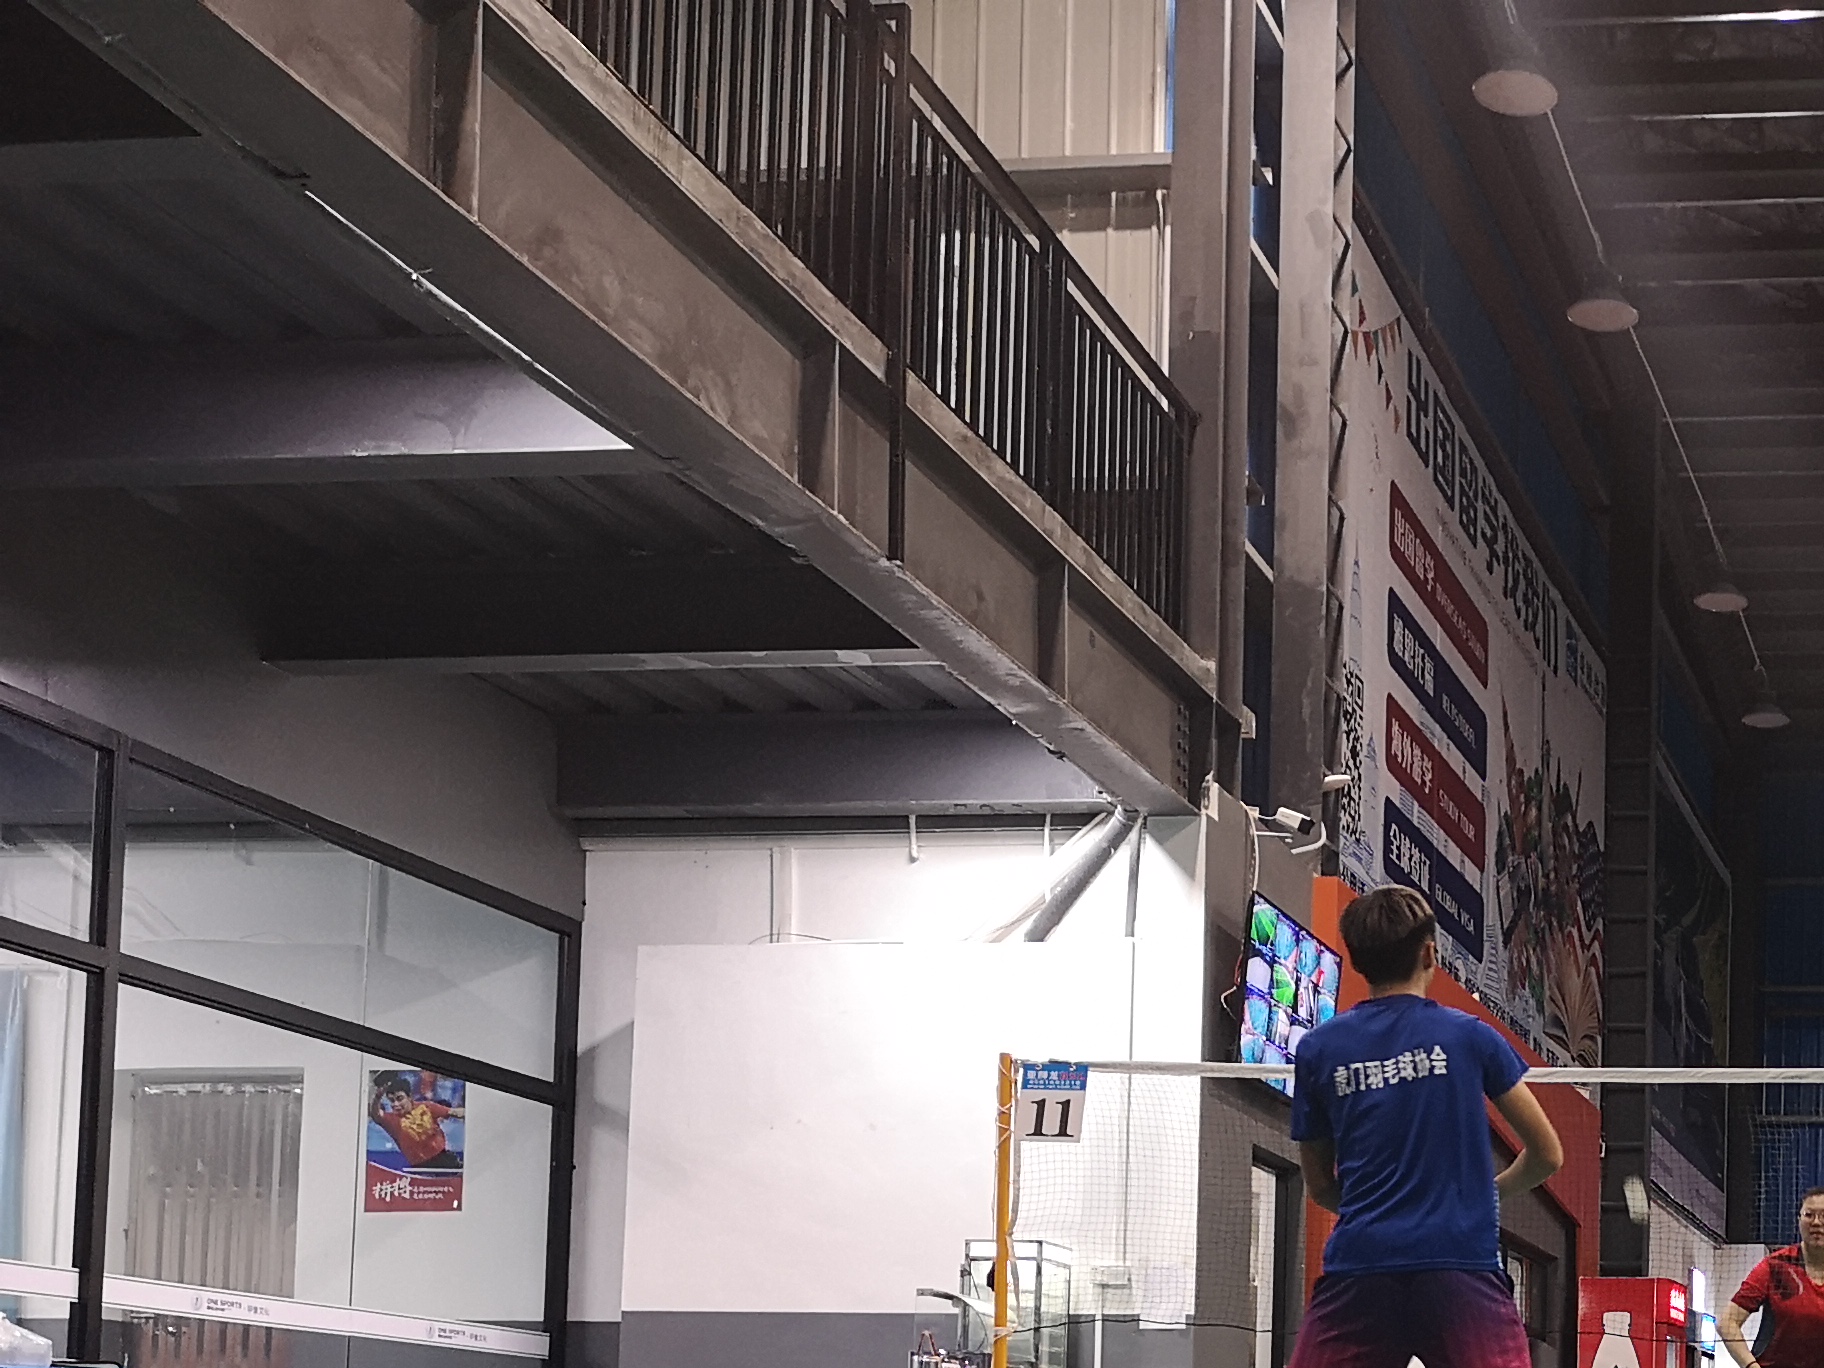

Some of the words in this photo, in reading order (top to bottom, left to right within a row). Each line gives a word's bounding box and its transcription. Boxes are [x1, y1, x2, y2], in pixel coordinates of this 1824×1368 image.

[1405, 347, 1558, 677] 出国留学找我们
[1393, 507, 1435, 592] 出国留学
[1393, 613, 1434, 697] 雅思托福
[1391, 717, 1433, 794] 海外游学
[1438, 788, 1459, 825] STUDY
[1460, 811, 1476, 843] TOUR
[1389, 822, 1431, 895] 全球签证
[1435, 883, 1459, 921] GLOBAL
[1460, 910, 1475, 936] VISA
[1333, 1045, 1448, 1097] 虎门羽毛球协会
[1025, 1098, 1074, 1138] 11
[372, 1176, 412, 1202] 拼搏
